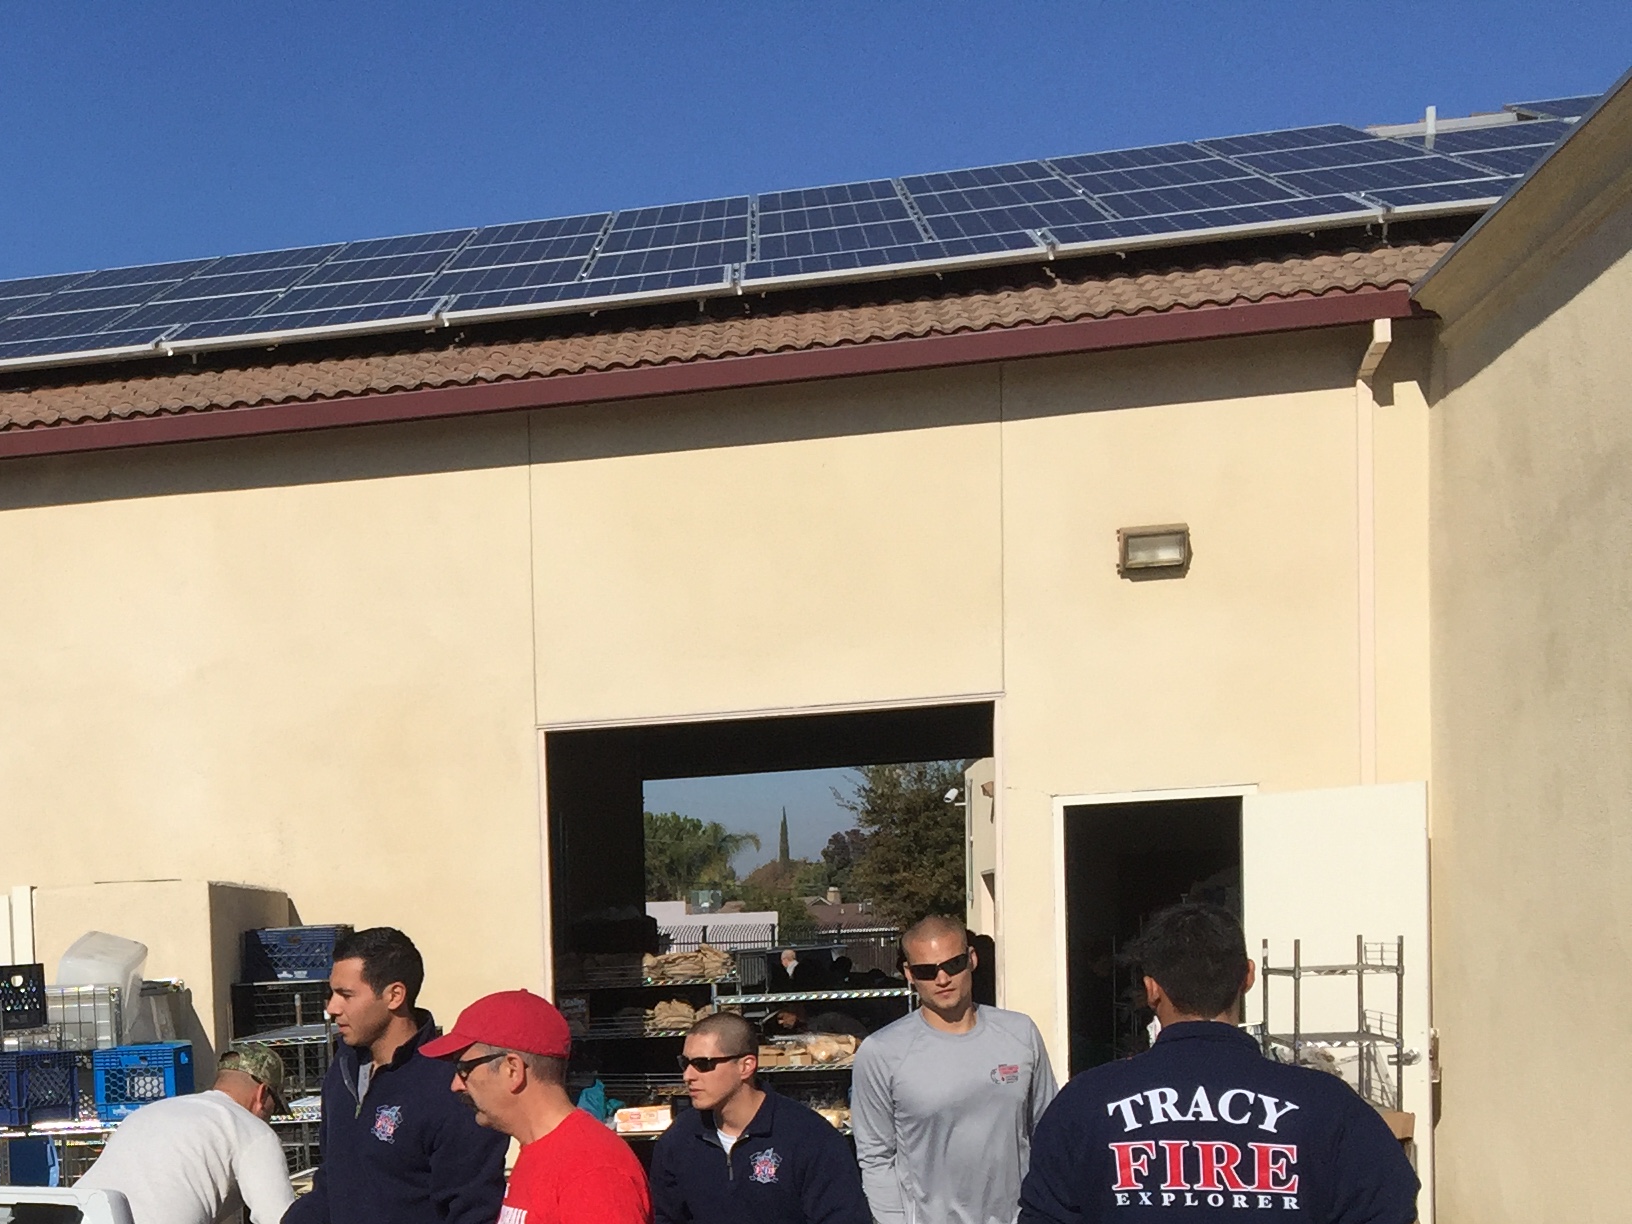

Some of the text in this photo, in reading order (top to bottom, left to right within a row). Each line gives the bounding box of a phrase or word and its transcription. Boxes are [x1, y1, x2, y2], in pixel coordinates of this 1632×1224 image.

[1107, 1085, 1300, 1133] TRACY
[1108, 1140, 1300, 1194] FIRE
[1115, 1191, 1300, 1210] EXPLORER
